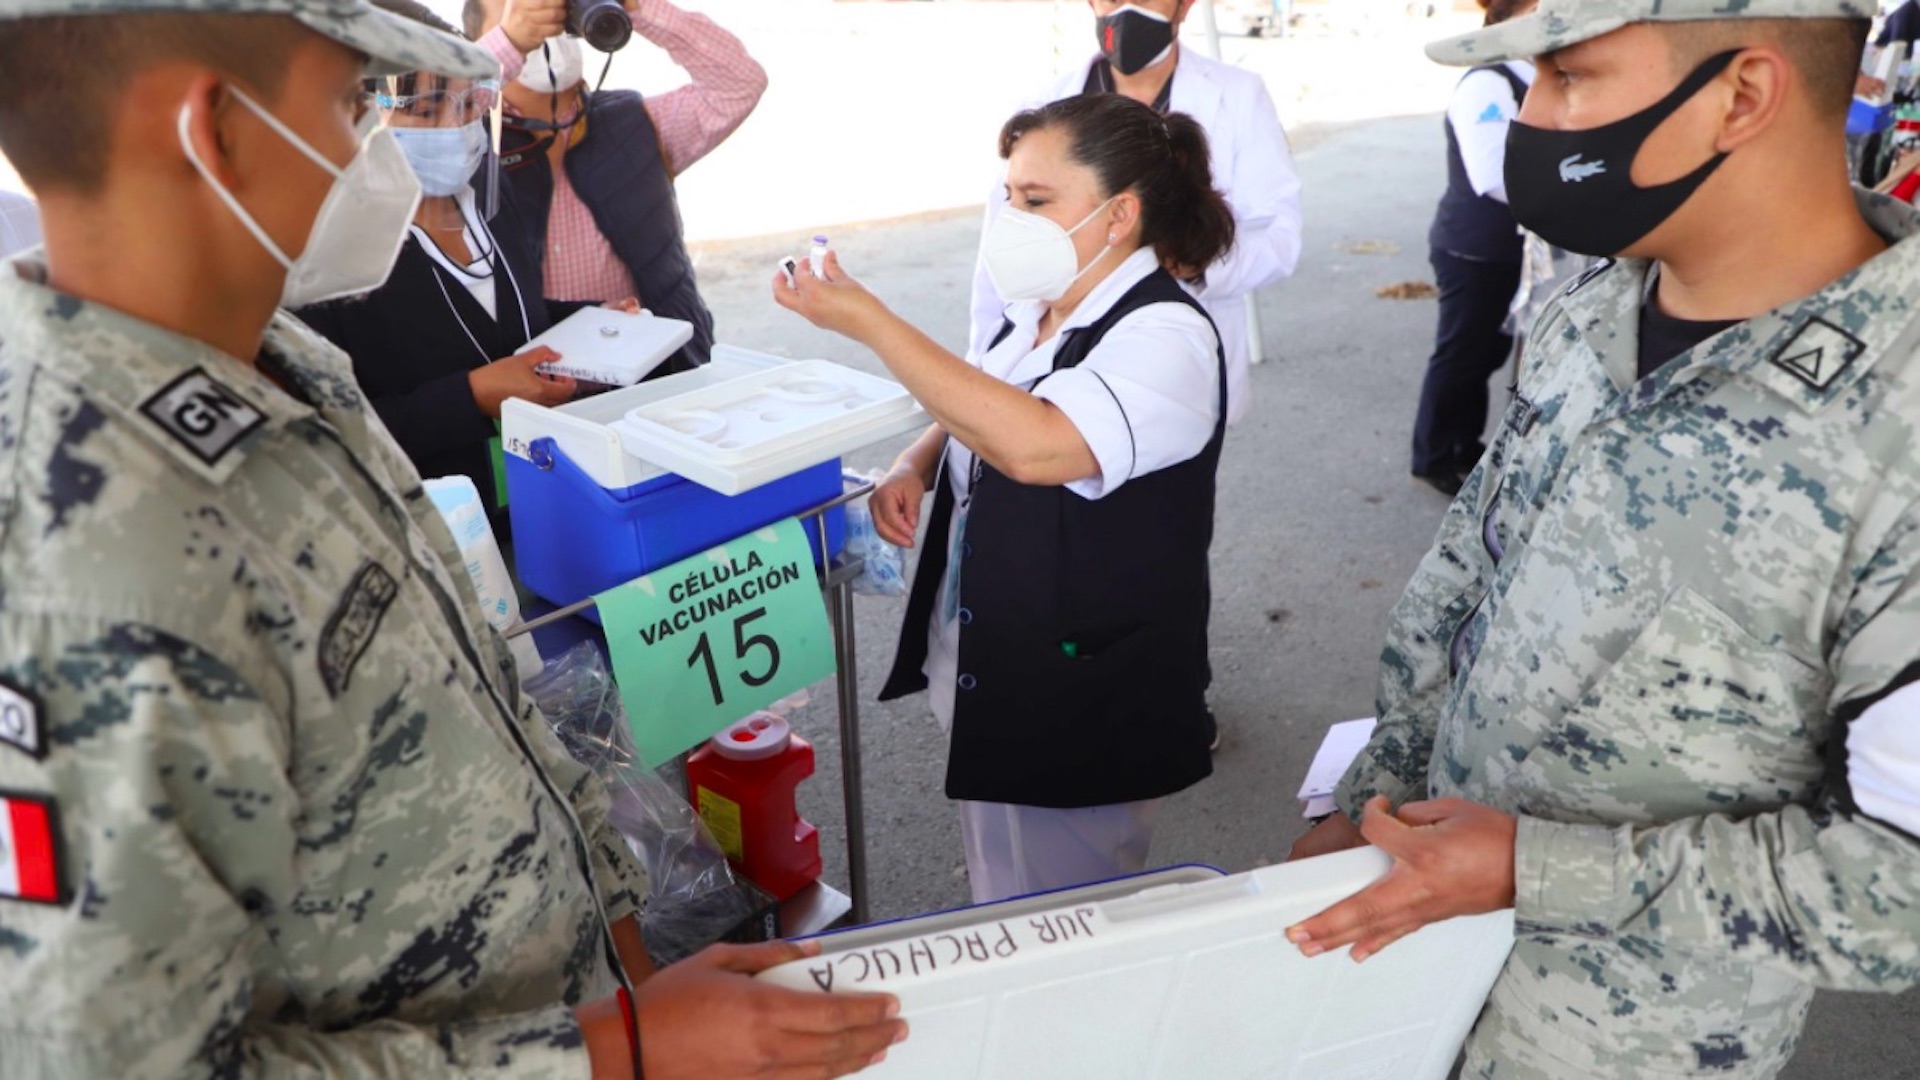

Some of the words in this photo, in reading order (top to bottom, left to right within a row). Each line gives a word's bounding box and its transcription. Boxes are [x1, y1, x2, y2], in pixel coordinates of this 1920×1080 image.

[175, 382, 243, 438] GN
[638, 561, 800, 646] VACUNACIÓN
[668, 550, 764, 604] CÉLULA
[686, 606, 781, 706] 15
[808, 921, 1019, 993] PACHUCA
[1029, 907, 1096, 945] JUR
